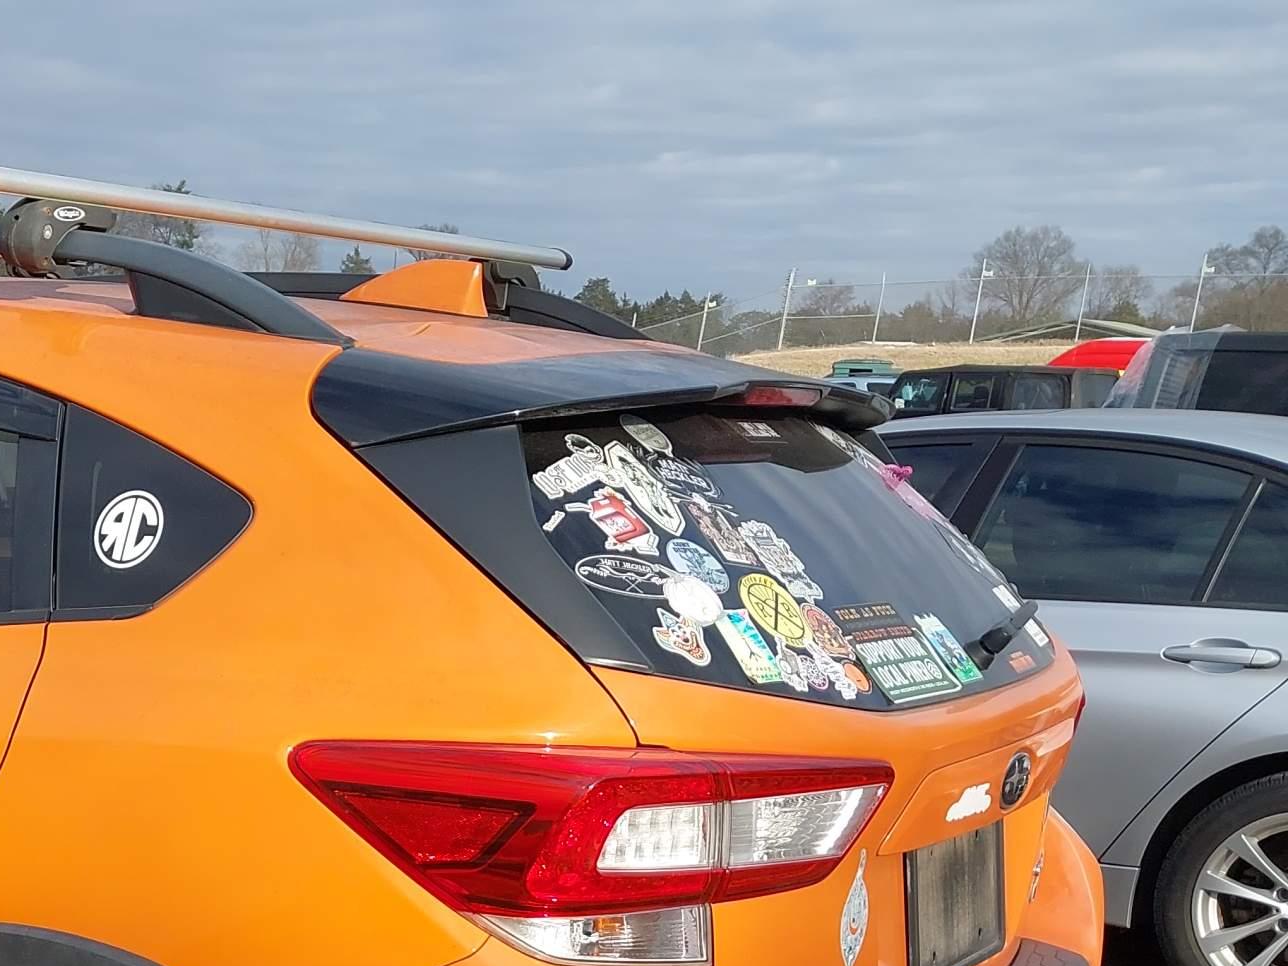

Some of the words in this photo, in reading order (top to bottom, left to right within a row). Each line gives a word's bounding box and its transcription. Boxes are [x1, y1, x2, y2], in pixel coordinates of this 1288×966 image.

[834, 608, 861, 621] FOLK
[862, 606, 874, 618] AS
[856, 638, 903, 665] SUPPORT
[896, 636, 928, 657] YOUR
[872, 662, 910, 689] LOCAL
